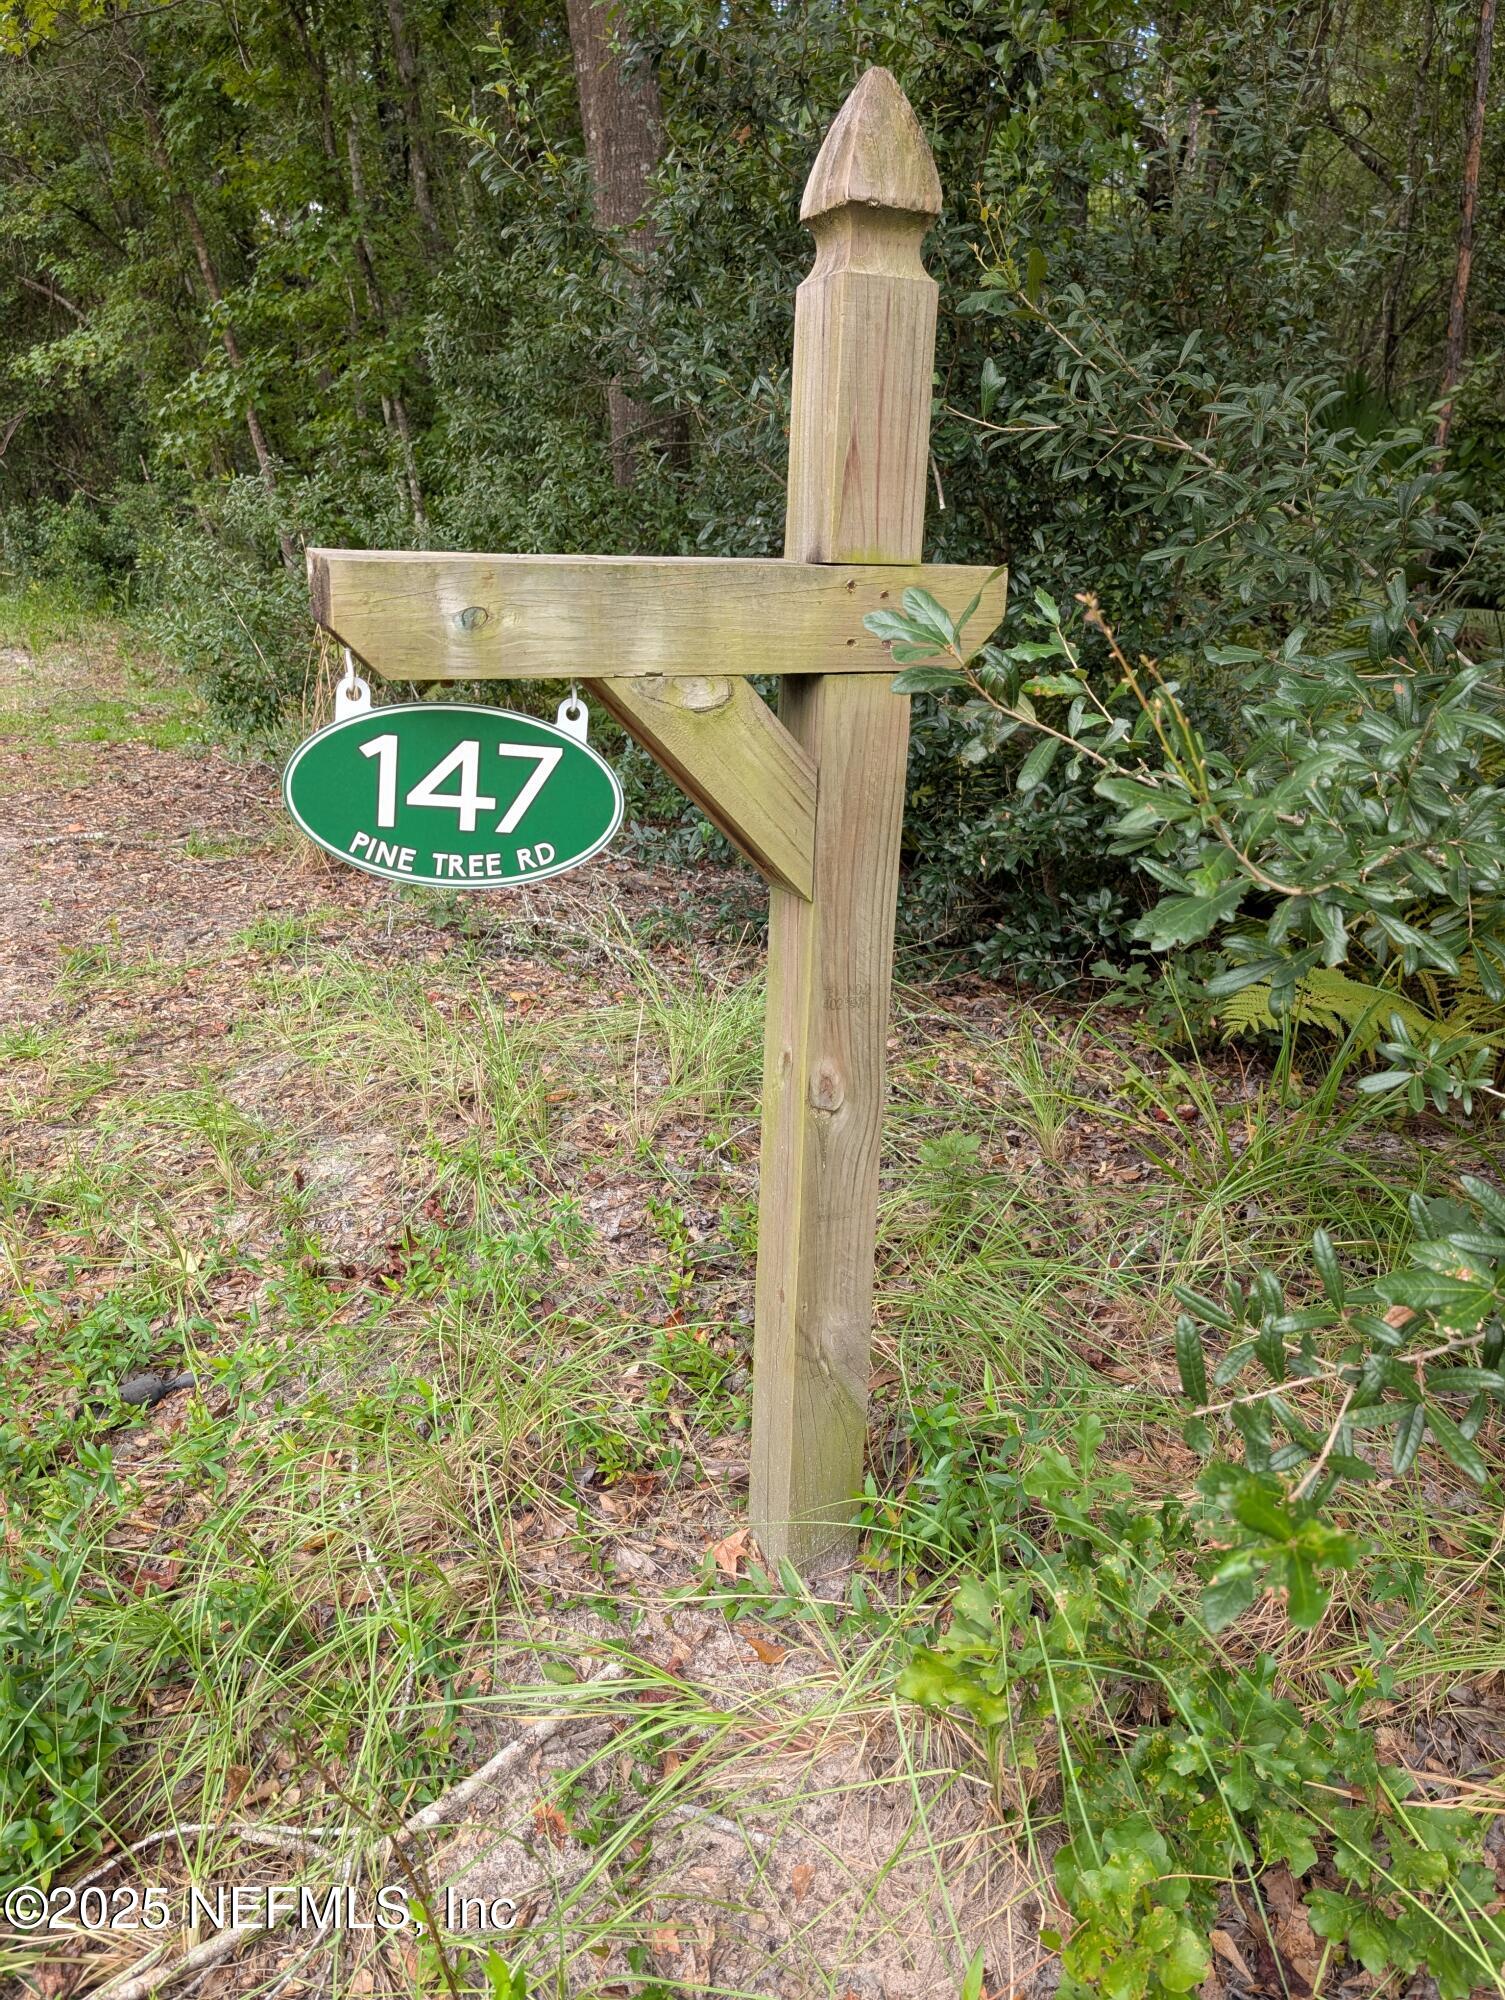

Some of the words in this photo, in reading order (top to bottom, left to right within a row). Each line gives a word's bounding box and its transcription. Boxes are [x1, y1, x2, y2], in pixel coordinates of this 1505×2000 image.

[358, 734, 564, 833] 147
[349, 831, 417, 872] PINE
[432, 853, 502, 877] TREE
[517, 842, 556, 871] RD
